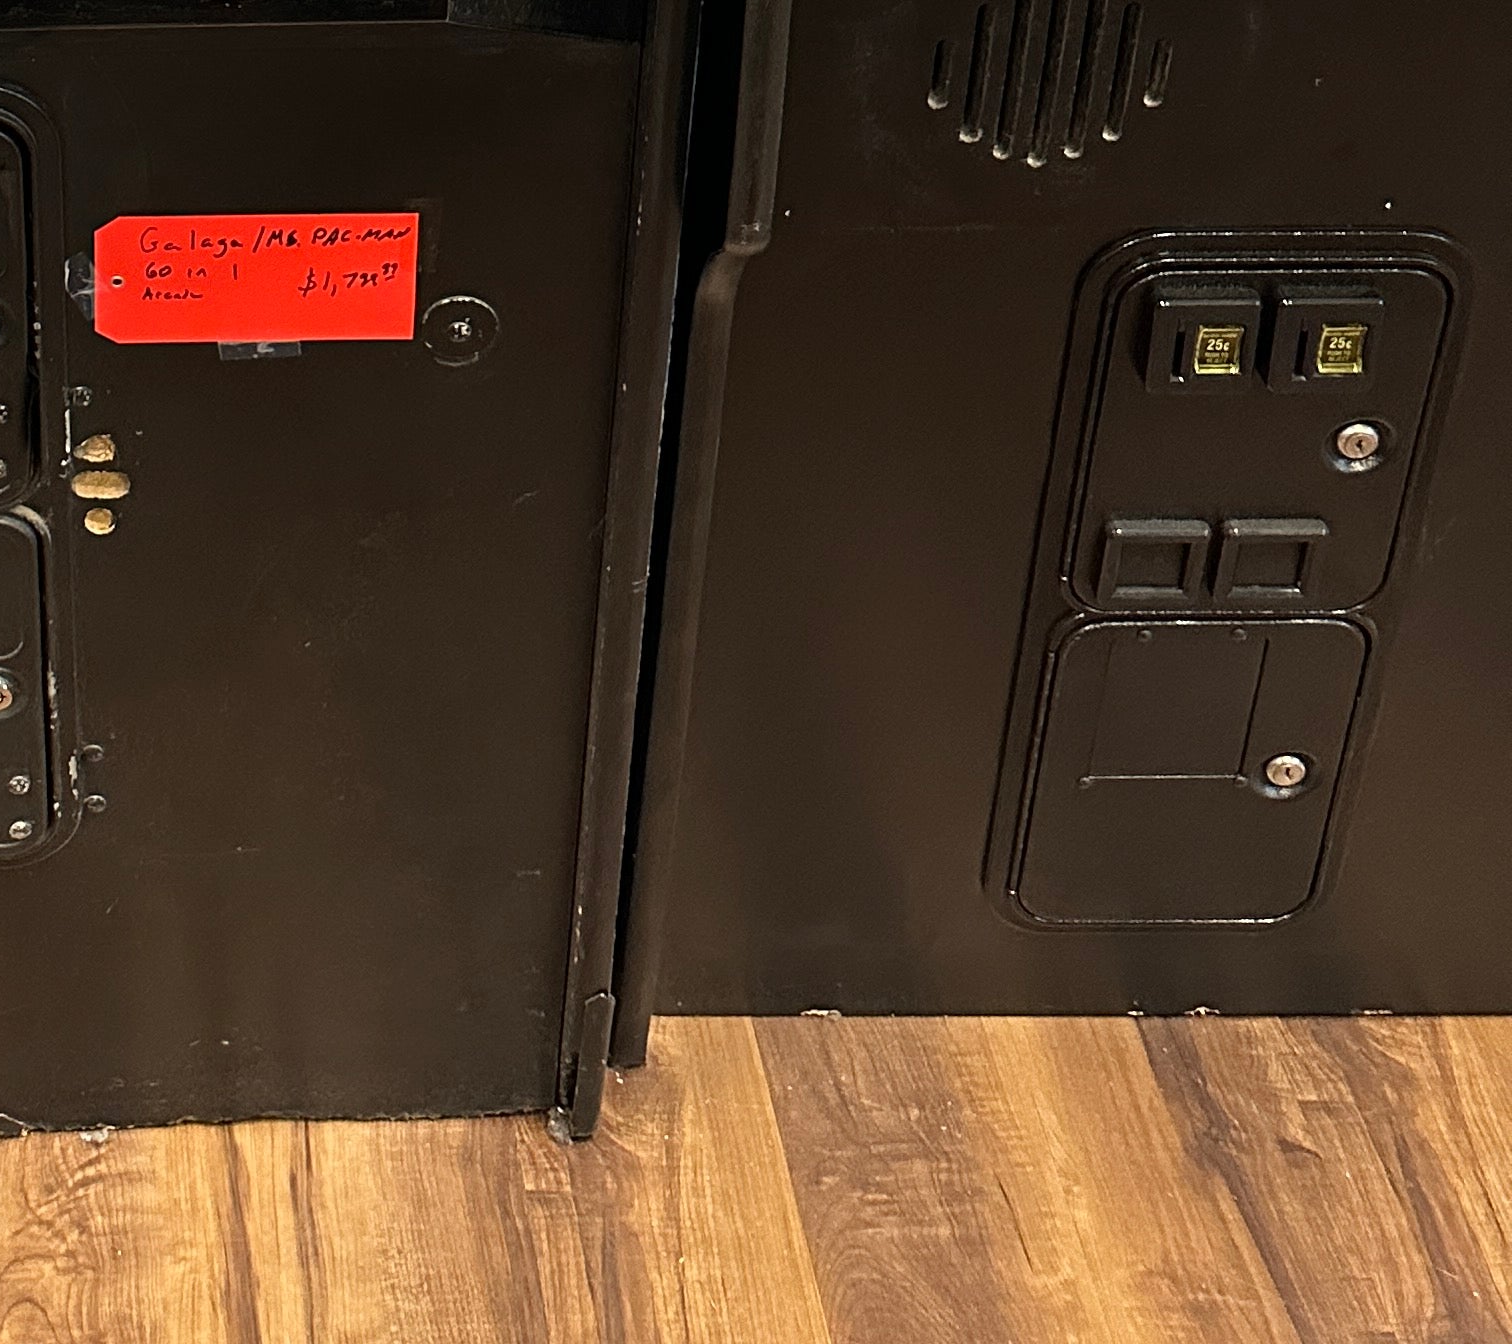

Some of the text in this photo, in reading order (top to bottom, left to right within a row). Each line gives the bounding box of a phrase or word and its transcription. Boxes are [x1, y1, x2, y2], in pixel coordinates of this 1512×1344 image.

[140, 226, 244, 258] Galaga
[145, 261, 172, 279] 60
[187, 267, 208, 279] in
[233, 263, 239, 280] 1
